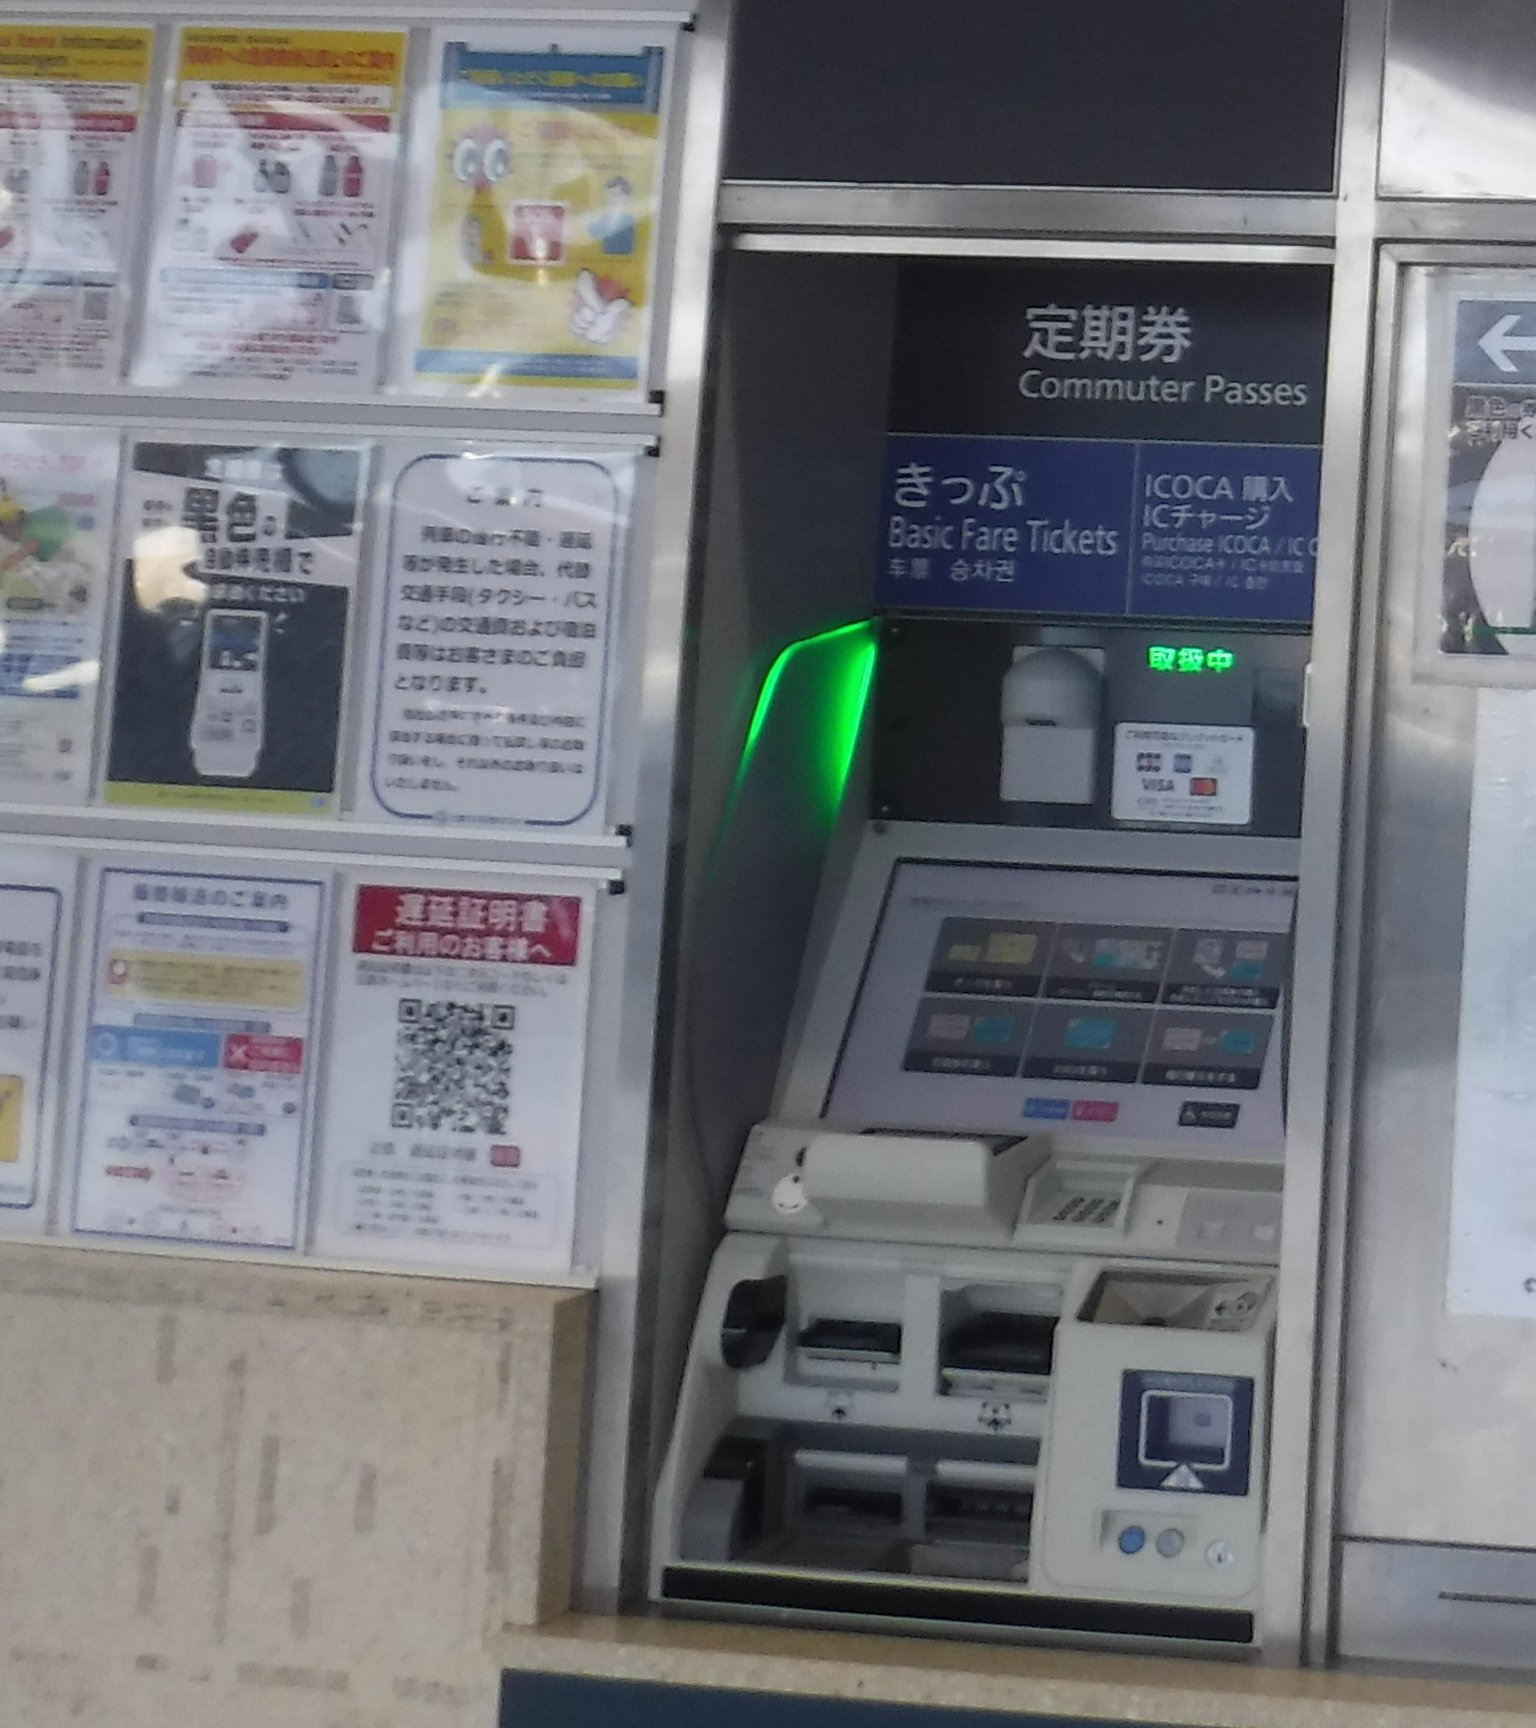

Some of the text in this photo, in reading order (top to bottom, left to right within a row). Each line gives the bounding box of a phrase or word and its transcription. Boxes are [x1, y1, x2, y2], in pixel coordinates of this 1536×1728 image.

[1023, 304, 1190, 362] 定期券
[1020, 370, 1307, 407] Commuter Passes
[896, 462, 1027, 509] きっぷ
[1144, 474, 1234, 502] ICOCA
[1143, 504, 1270, 530] ICチャージ
[889, 516, 1119, 557] Basic Fare Tickets
[1142, 533, 1210, 553] Purchase
[1218, 535, 1270, 555] ICOCA
